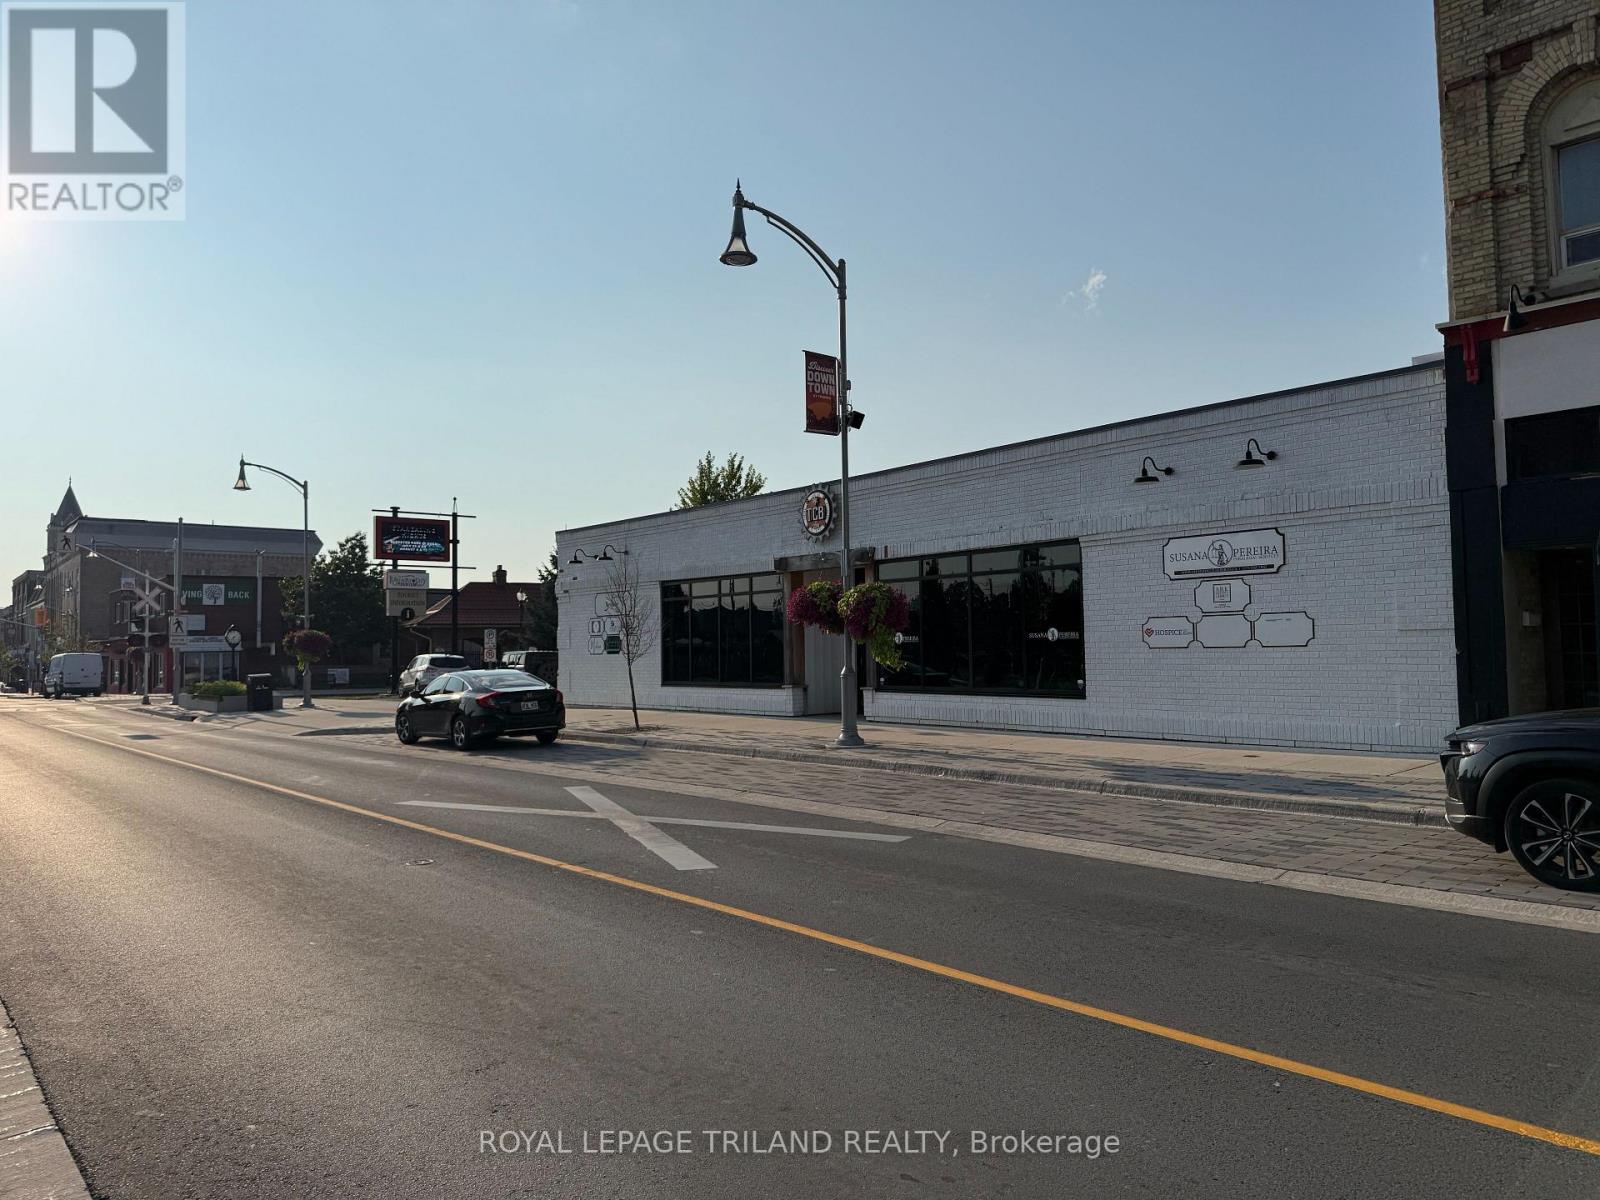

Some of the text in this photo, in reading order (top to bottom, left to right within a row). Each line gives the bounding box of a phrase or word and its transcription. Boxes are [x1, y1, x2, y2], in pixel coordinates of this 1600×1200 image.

[807, 370, 836, 385] DOWN
[807, 382, 836, 396] TOWN
[806, 506, 825, 522] TCB
[1169, 551, 1209, 563] SUSANA
[1233, 545, 1278, 558] PEREIRA
[227, 591, 250, 600] BACK
